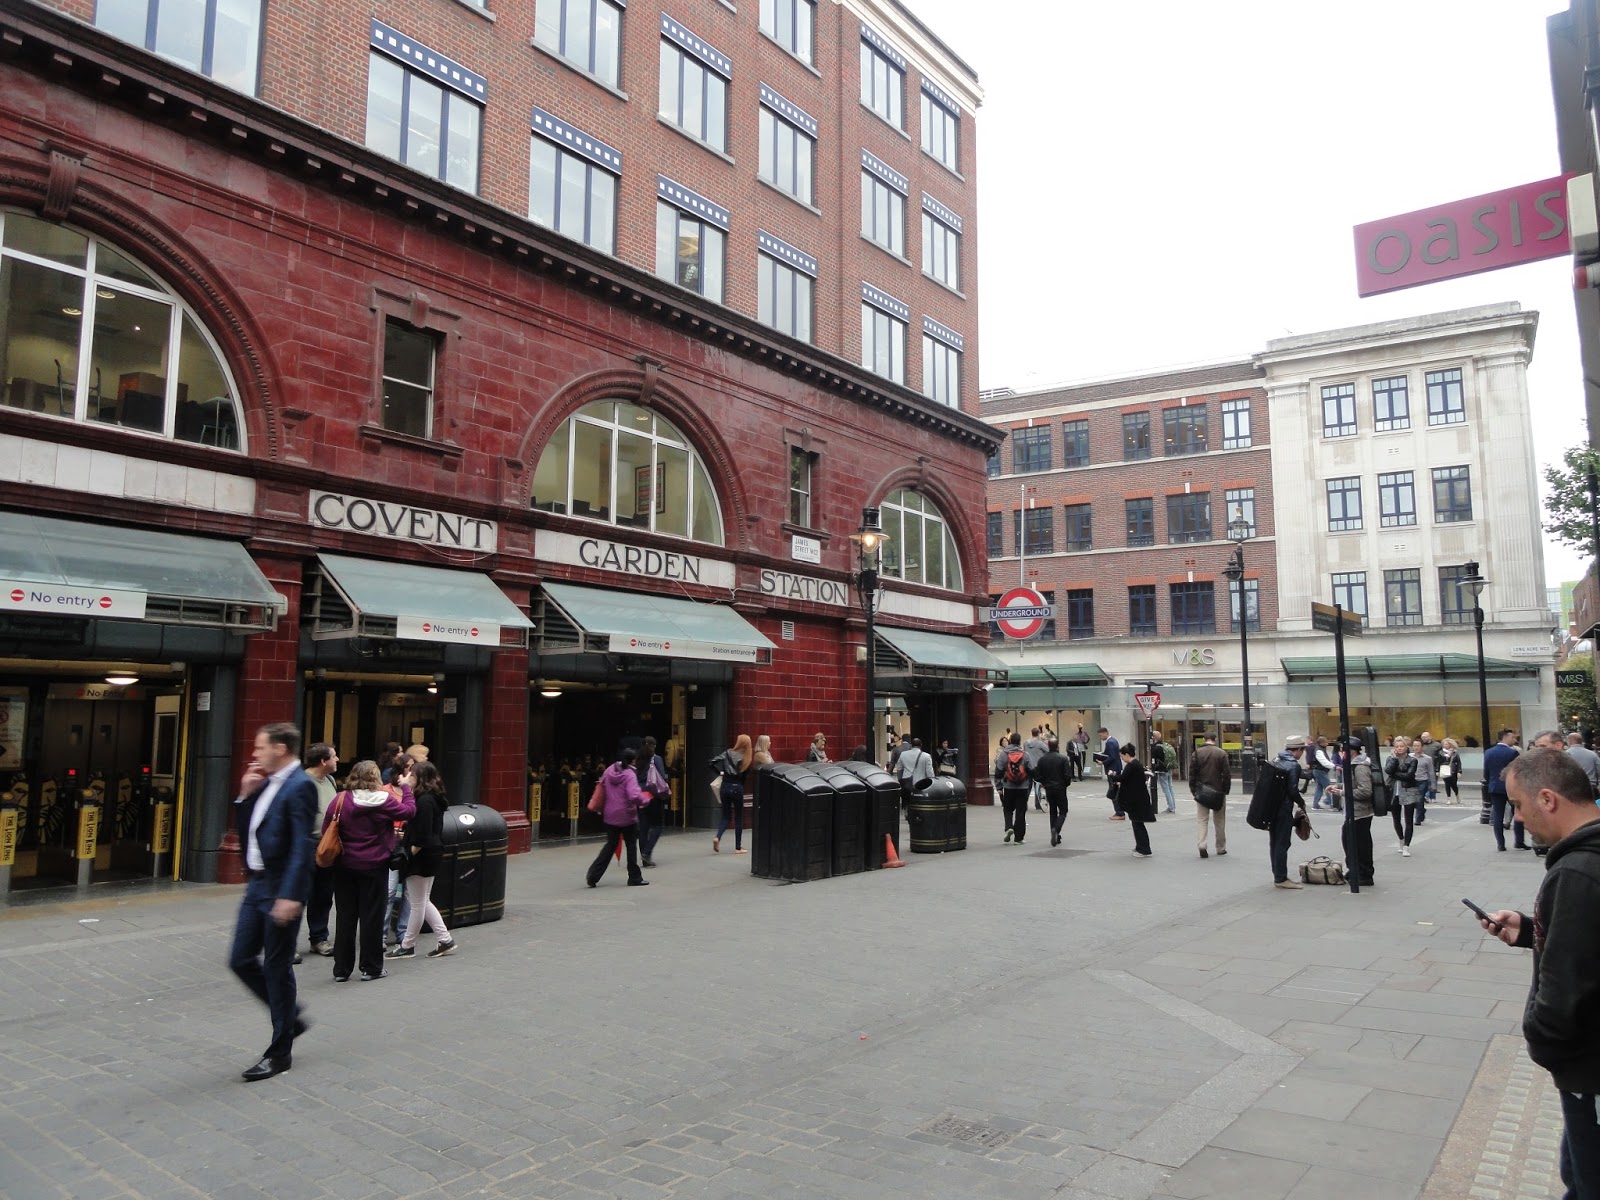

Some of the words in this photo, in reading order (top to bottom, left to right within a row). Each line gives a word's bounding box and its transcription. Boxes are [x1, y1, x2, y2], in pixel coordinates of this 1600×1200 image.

[1367, 190, 1566, 275] oasis
[314, 494, 493, 549] COVENT
[795, 546, 808, 554] STREET
[579, 539, 701, 582] GARDEN
[761, 570, 847, 605] STATION
[30, 591, 52, 604] No
[56, 595, 95, 609] entry
[991, 608, 1050, 618] UNDERGROUND
[434, 624, 445, 632] No
[448, 628, 468, 636] entry
[638, 640, 647, 648] No
[648, 642, 664, 651] entry
[712, 646, 730, 654] Station
[1172, 648, 1215, 666] M&S
[1558, 674, 1584, 684] M&S
[5, 828, 14, 844] LION
[86, 823, 95, 838] LION
[4, 845, 14, 861] KING
[86, 839, 94, 855] KING
